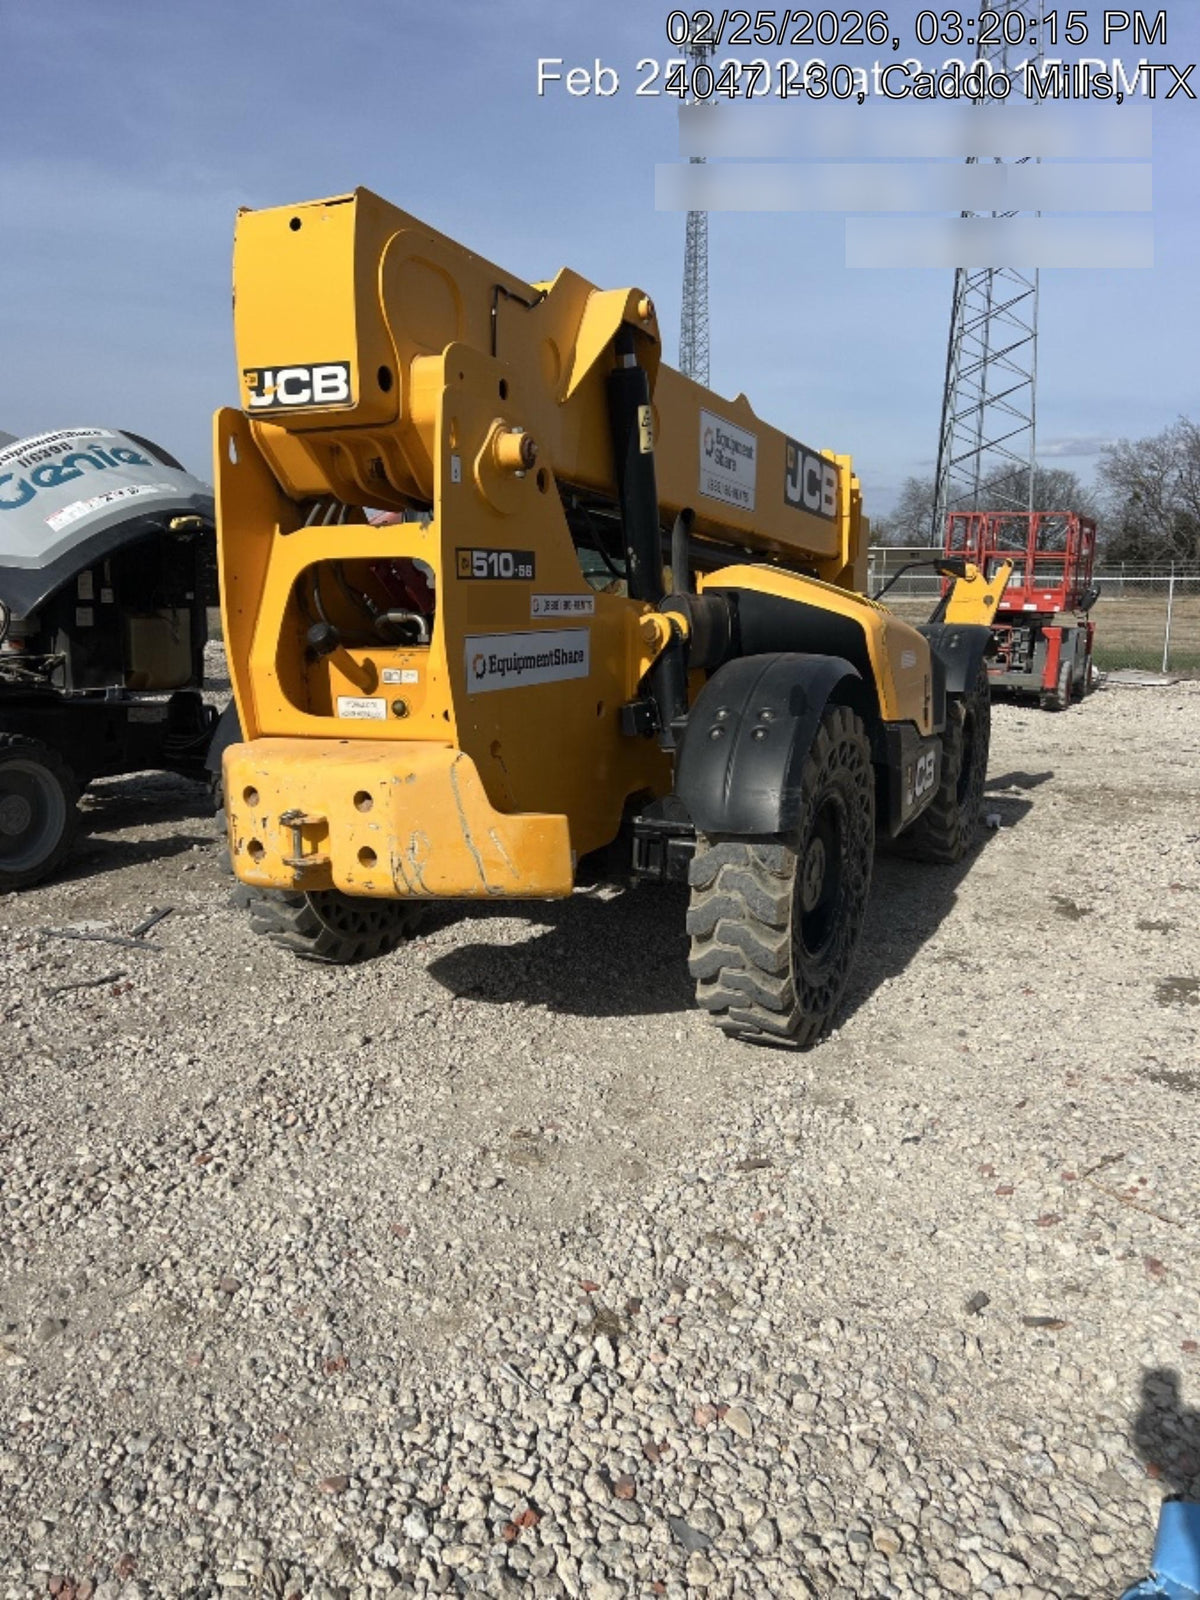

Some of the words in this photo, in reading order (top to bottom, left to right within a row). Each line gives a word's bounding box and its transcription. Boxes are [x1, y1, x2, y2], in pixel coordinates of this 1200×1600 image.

[249, 365, 349, 407] JCB
[0, 443, 153, 511] Genie
[786, 446, 838, 518] JCB
[488, 648, 585, 677] EquipmentShare
